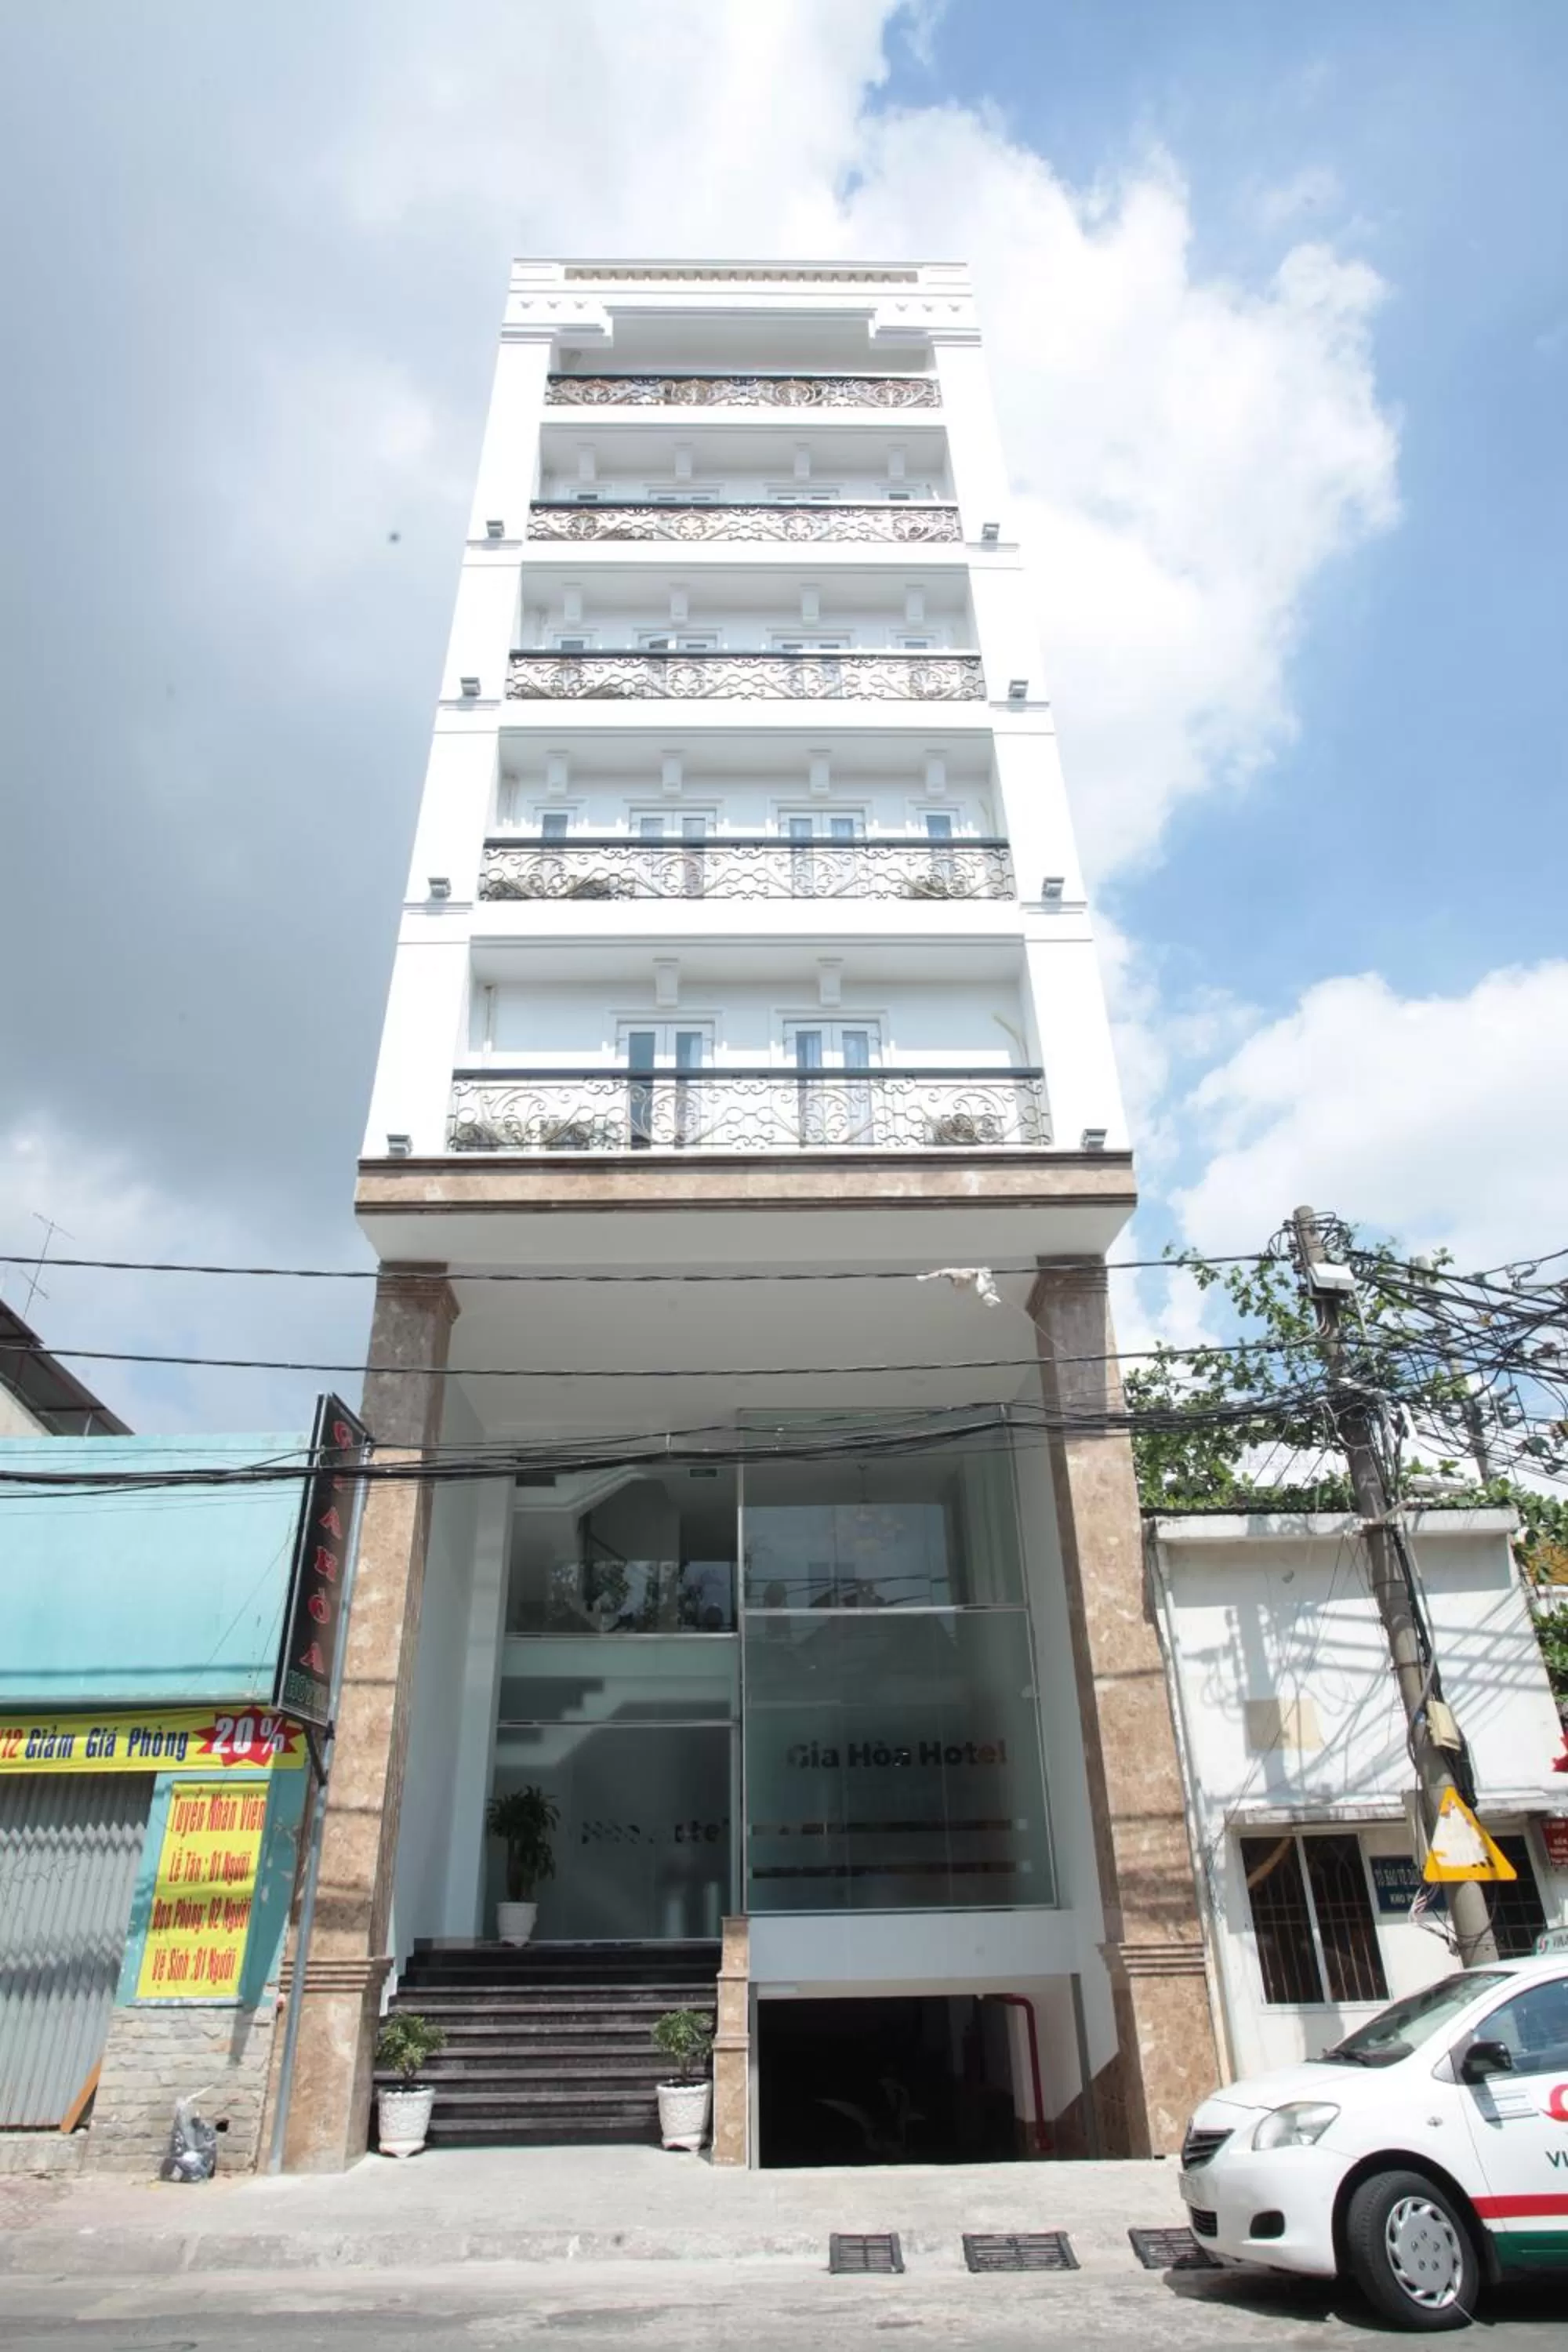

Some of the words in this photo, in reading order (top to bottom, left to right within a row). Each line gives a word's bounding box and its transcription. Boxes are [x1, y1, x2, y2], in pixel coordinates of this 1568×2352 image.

[25, 1724, 75, 1760] Giảm
[85, 1726, 118, 1759] Giá
[127, 1725, 189, 1762] Phòng
[212, 1716, 285, 1754] 20%
[786, 1740, 840, 1769] Gia
[918, 1738, 1007, 1766] Hotel
